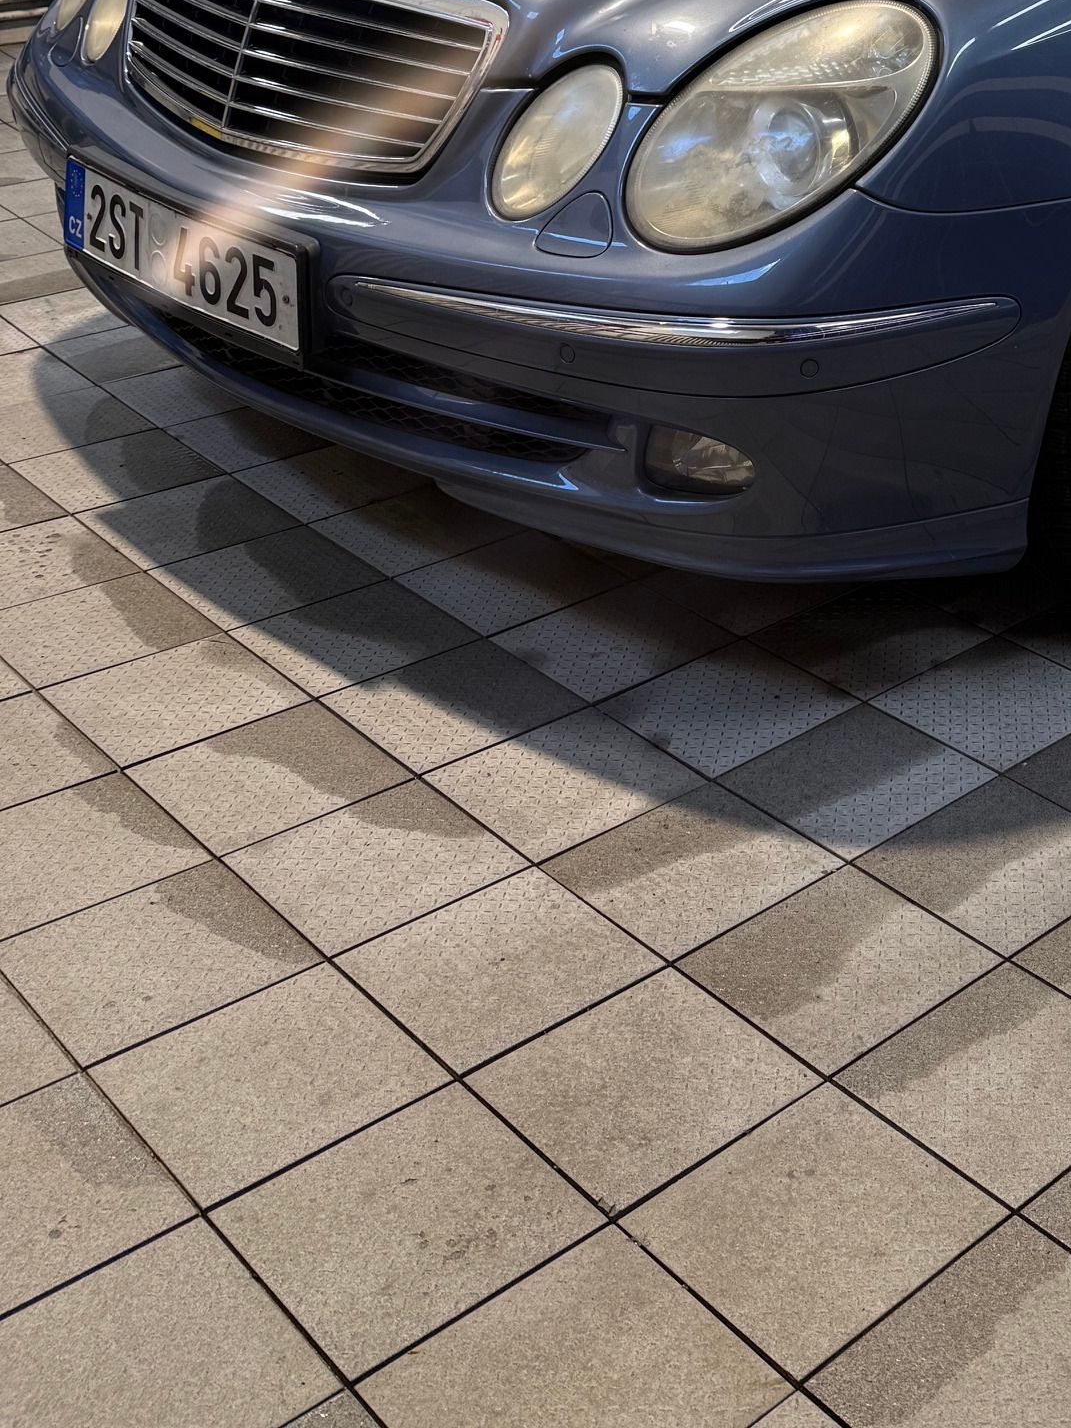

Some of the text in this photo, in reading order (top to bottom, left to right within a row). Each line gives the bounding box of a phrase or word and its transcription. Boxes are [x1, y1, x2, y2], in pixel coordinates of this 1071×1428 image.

[68, 215, 82, 239] CZ
[89, 184, 277, 327] 2ST 4625
